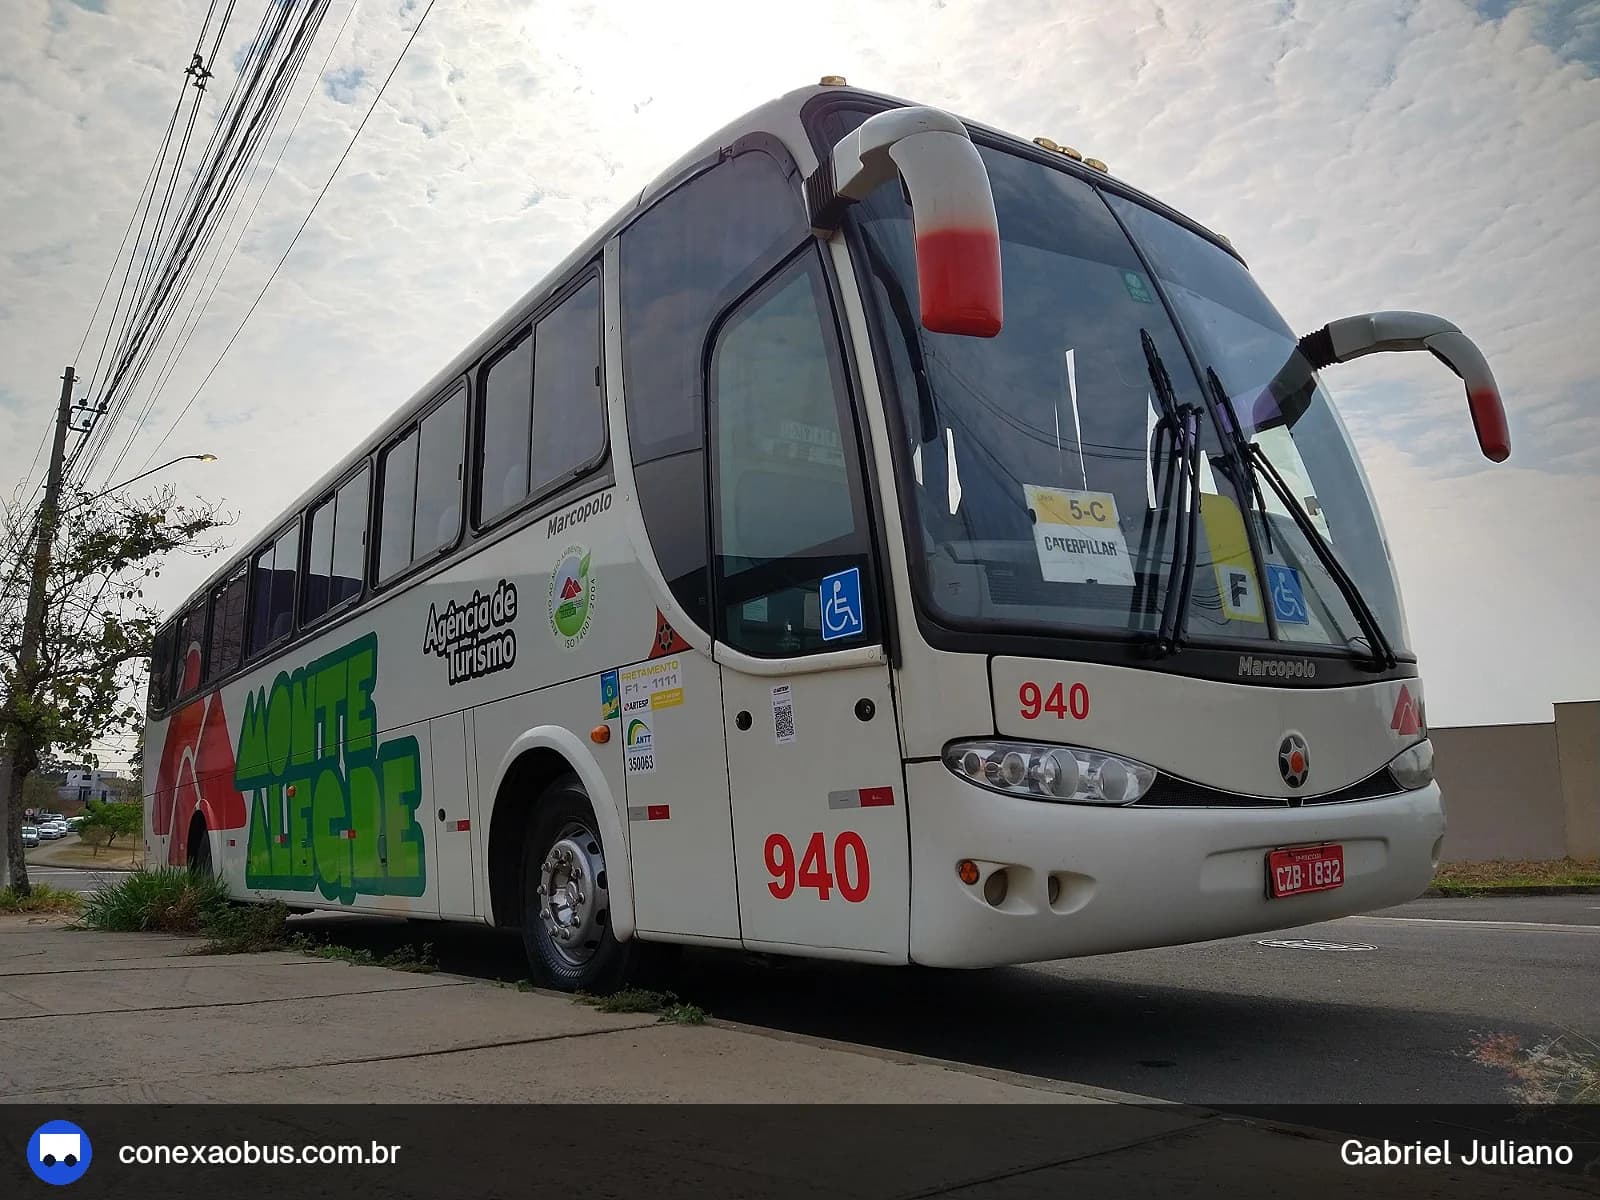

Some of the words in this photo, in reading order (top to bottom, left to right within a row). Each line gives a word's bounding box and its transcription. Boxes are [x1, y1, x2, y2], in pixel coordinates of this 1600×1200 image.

[547, 492, 613, 540] Marcopolo
[1069, 499, 1106, 522] 5-C
[1044, 535, 1118, 556] CATERPILLAR
[1229, 572, 1249, 607] F
[423, 588, 491, 654] Agência
[491, 579, 517, 624] de
[447, 628, 517, 685] Turismo
[564, 639, 575, 649] ISO
[621, 660, 679, 681] FRETAMENTO
[1237, 654, 1317, 680] Marcopolo
[625, 682, 640, 695] F1
[652, 674, 678, 689] 1111
[235, 638, 376, 786] MONTE
[628, 698, 649, 711] ARTESP
[1019, 682, 1090, 720] 940
[635, 734, 652, 745] ANTT
[628, 754, 654, 772] 350063
[246, 745, 424, 898] ALEGRE
[763, 831, 871, 903] 940
